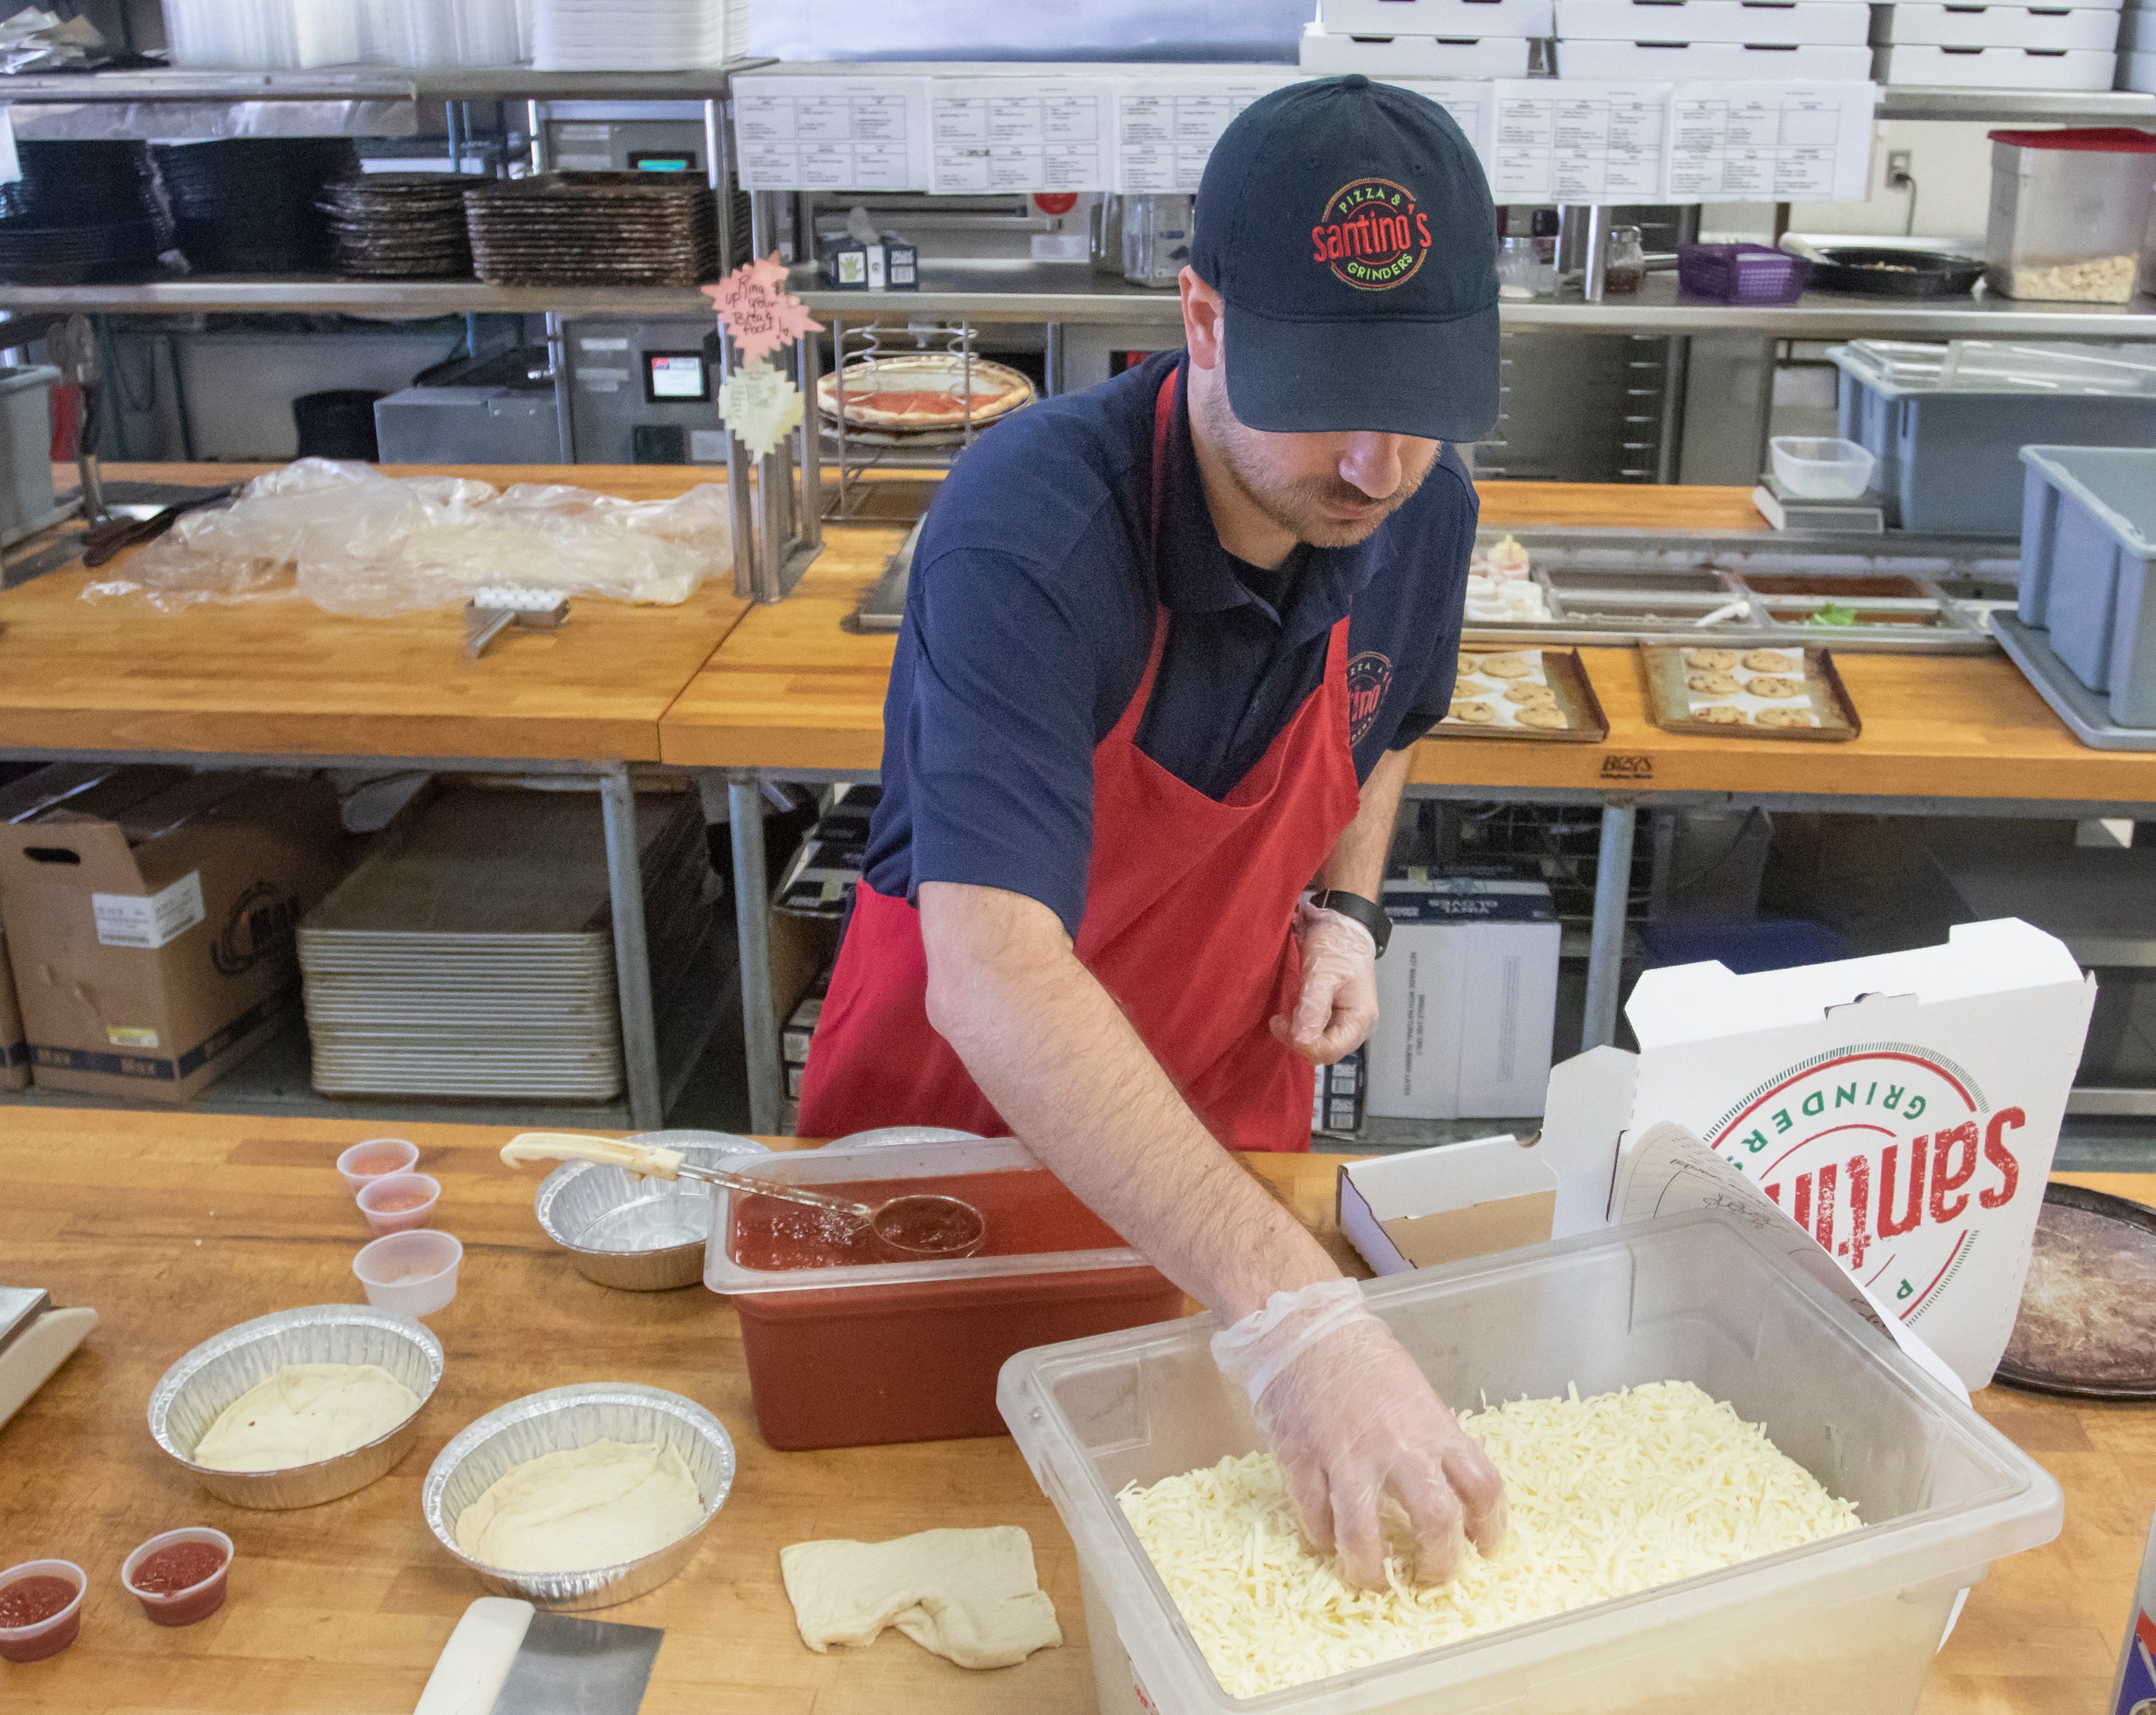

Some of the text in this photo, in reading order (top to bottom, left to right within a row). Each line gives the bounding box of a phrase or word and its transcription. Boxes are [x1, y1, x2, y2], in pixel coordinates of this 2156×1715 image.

[1338, 188, 1401, 213] PIZZA &
[1312, 203, 1432, 262] santino's
[1347, 253, 1413, 281] GRINDERS
[1764, 1105, 2027, 1272] santi
